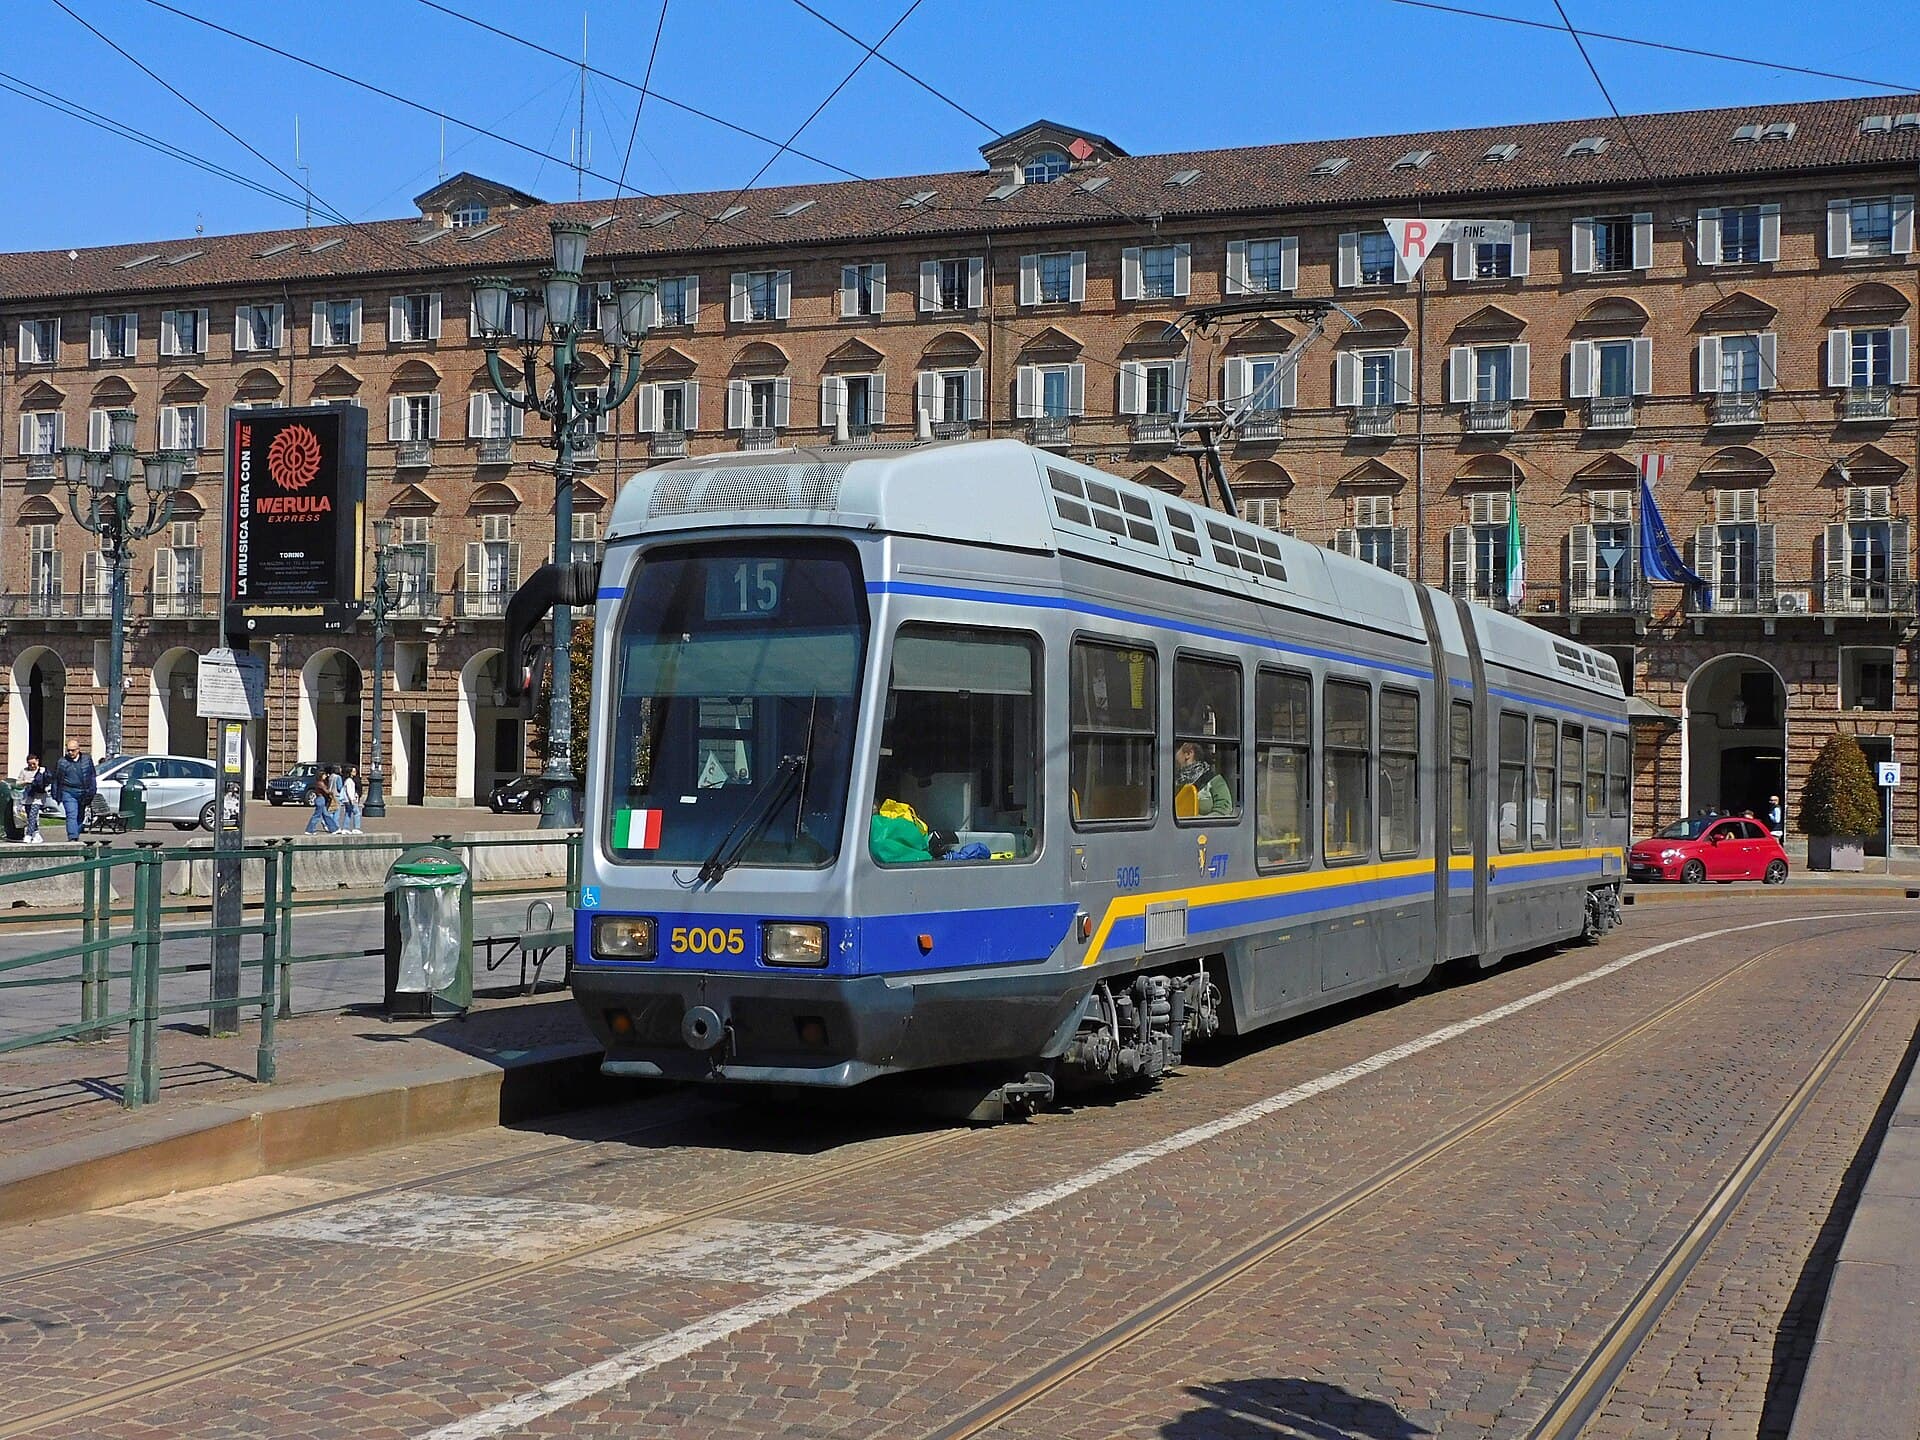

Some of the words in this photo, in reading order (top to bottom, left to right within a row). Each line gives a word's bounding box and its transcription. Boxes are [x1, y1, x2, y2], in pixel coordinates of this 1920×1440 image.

[1402, 221, 1428, 258] R
[1462, 225, 1486, 238] FINE
[240, 450, 251, 482] CON
[240, 483, 250, 518] GIRA
[256, 496, 332, 514] MERULA
[267, 514, 321, 523] EXPRESS
[238, 520, 249, 577] MUSICA
[279, 551, 305, 559] TORINO
[238, 577, 248, 596] LA
[733, 562, 777, 611] 15
[1115, 866, 1141, 889] 5005
[670, 927, 745, 955] 5005
